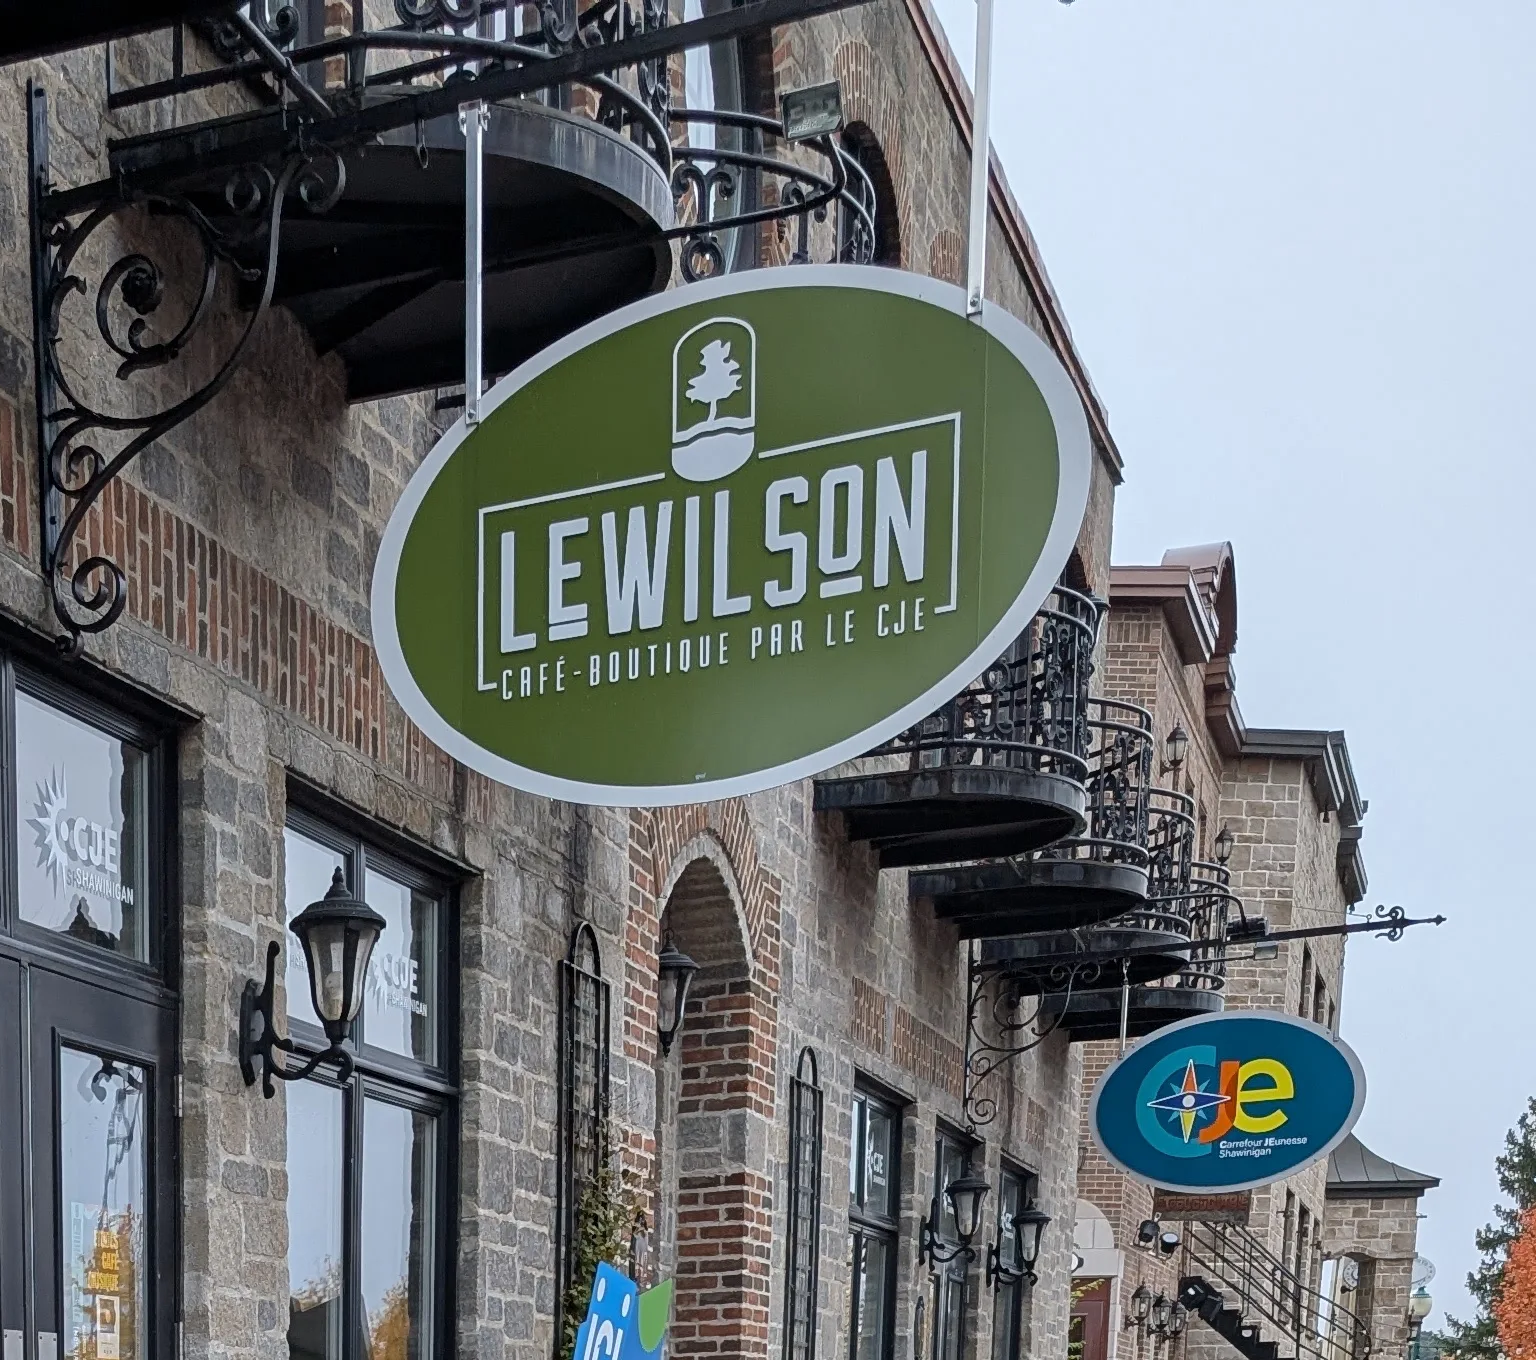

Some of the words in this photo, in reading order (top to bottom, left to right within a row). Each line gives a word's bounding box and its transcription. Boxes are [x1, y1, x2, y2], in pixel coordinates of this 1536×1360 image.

[499, 450, 929, 654] LEWILSON
[501, 632, 730, 702] CAFÉ-BOUTIQUE
[750, 618, 804, 660] PAR
[826, 609, 856, 648] LE
[877, 596, 928, 638] CJE
[74, 816, 118, 875] CJE
[76, 867, 134, 906] SHAWINIGAN
[1218, 1148, 1272, 1159] Shawinigan
[1219, 1137, 1264, 1149] Carrefour
[1264, 1136, 1308, 1147] JEunesse
